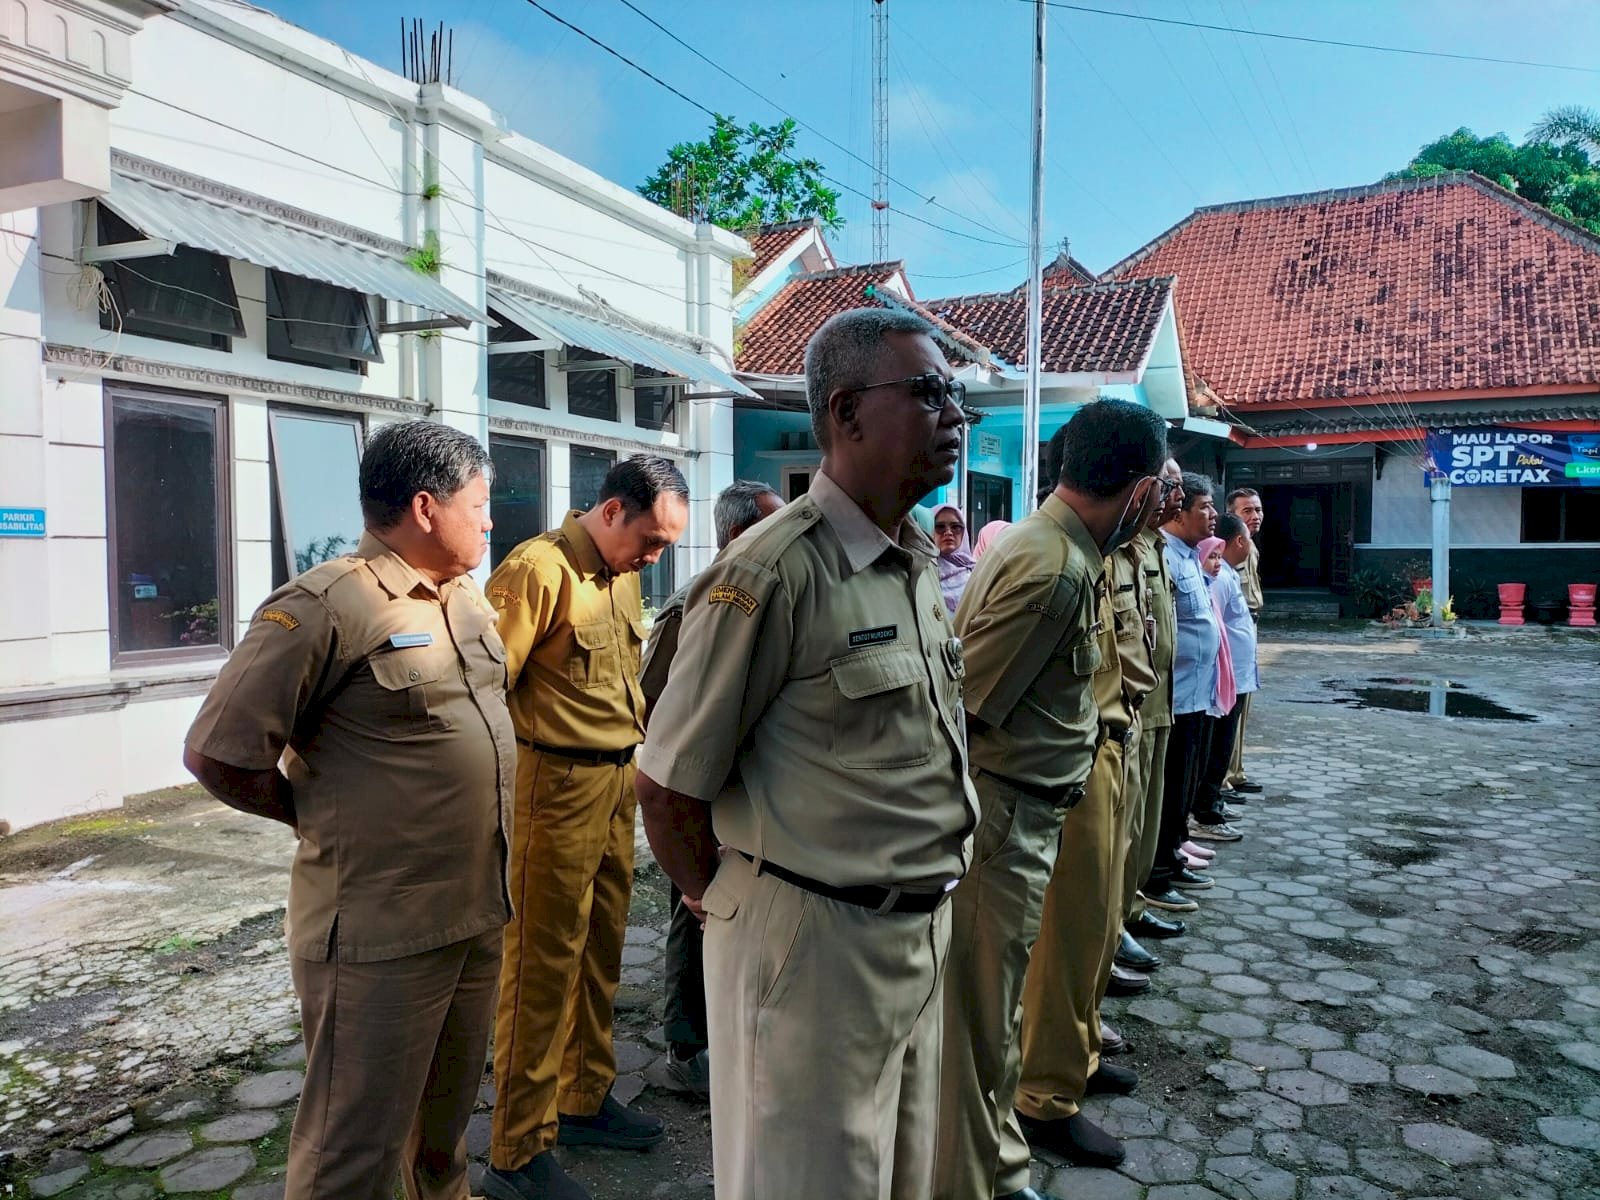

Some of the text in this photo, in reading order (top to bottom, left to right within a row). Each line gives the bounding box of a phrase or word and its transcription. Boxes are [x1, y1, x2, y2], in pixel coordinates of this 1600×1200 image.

[1452, 433, 1553, 445] MAU LAPOR
[1451, 445, 1544, 467] SPT Pakai
[1450, 469, 1551, 484] CORETAX
[3, 512, 36, 522] PARKIR
